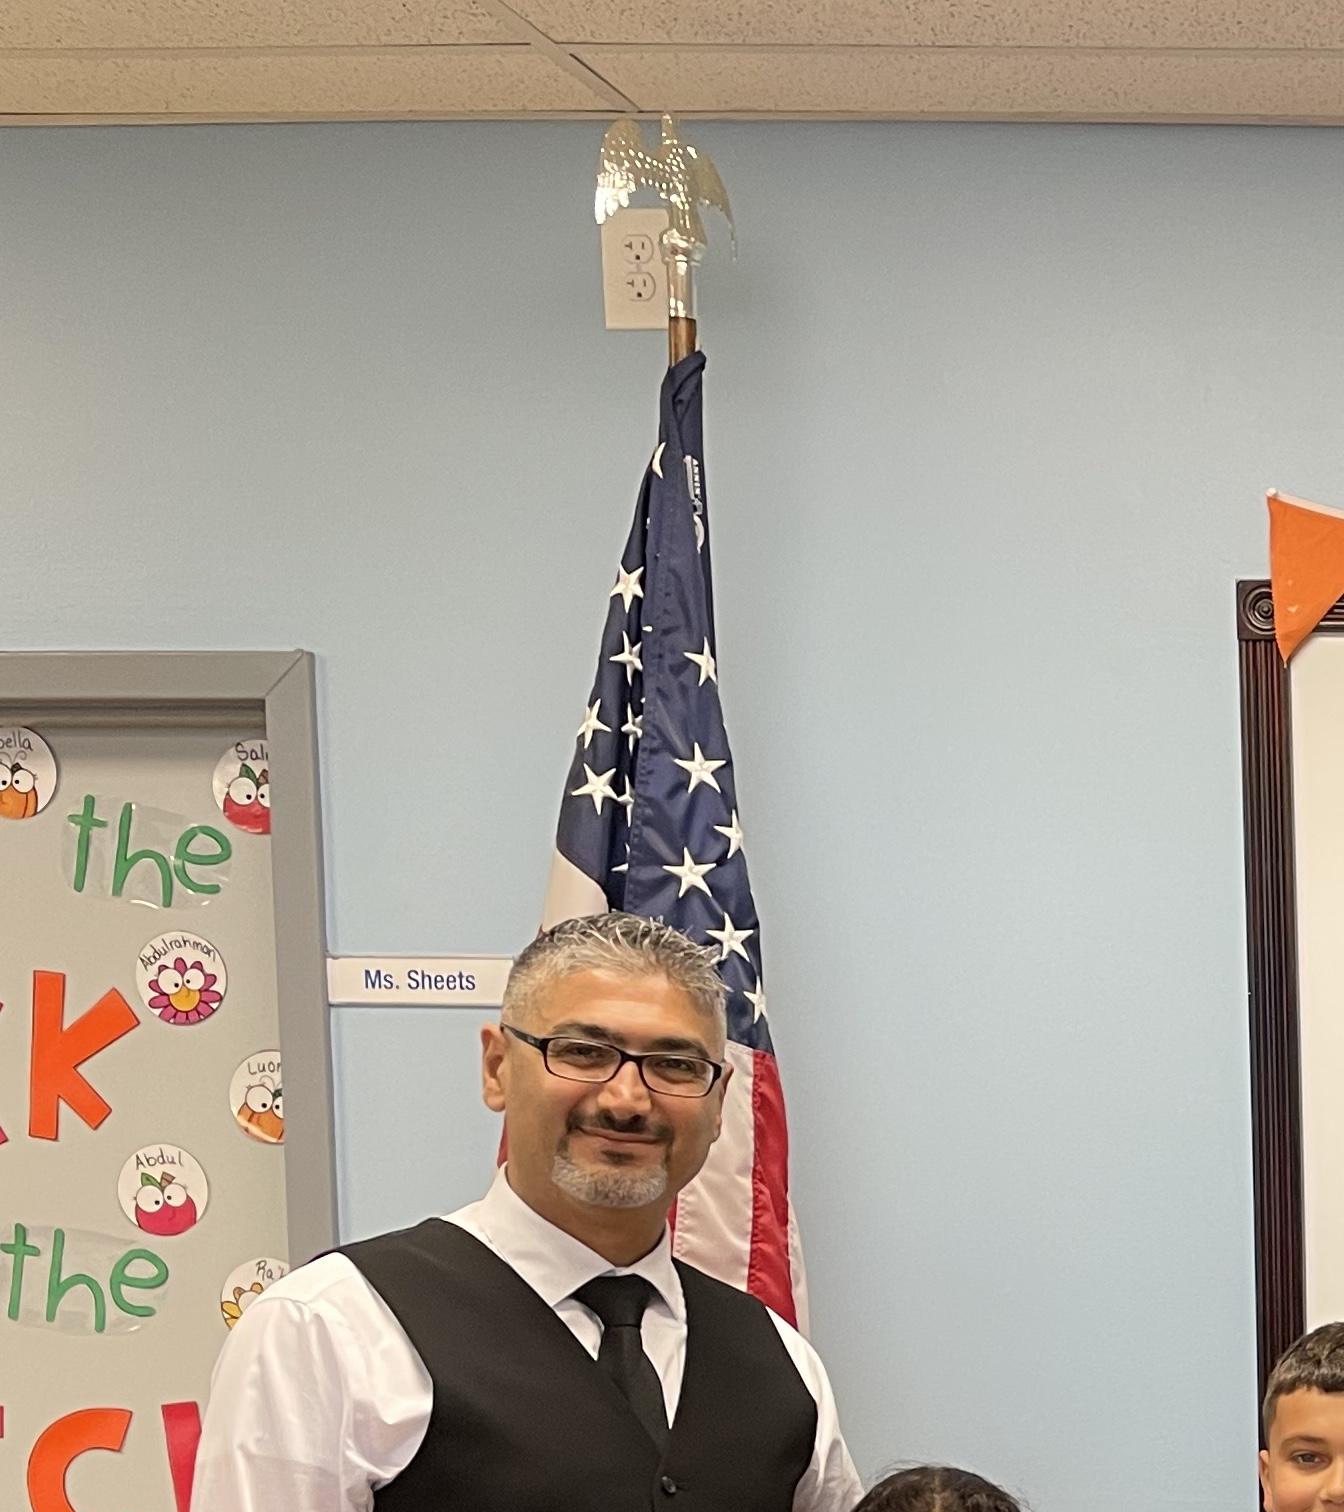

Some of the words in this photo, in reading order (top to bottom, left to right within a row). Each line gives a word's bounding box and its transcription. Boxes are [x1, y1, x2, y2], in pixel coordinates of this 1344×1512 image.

[67, 794, 232, 907] the
[364, 969, 400, 990] Ms.
[407, 969, 476, 990] Sheets
[135, 1147, 184, 1170] Abdul
[0, 1222, 169, 1333] the
